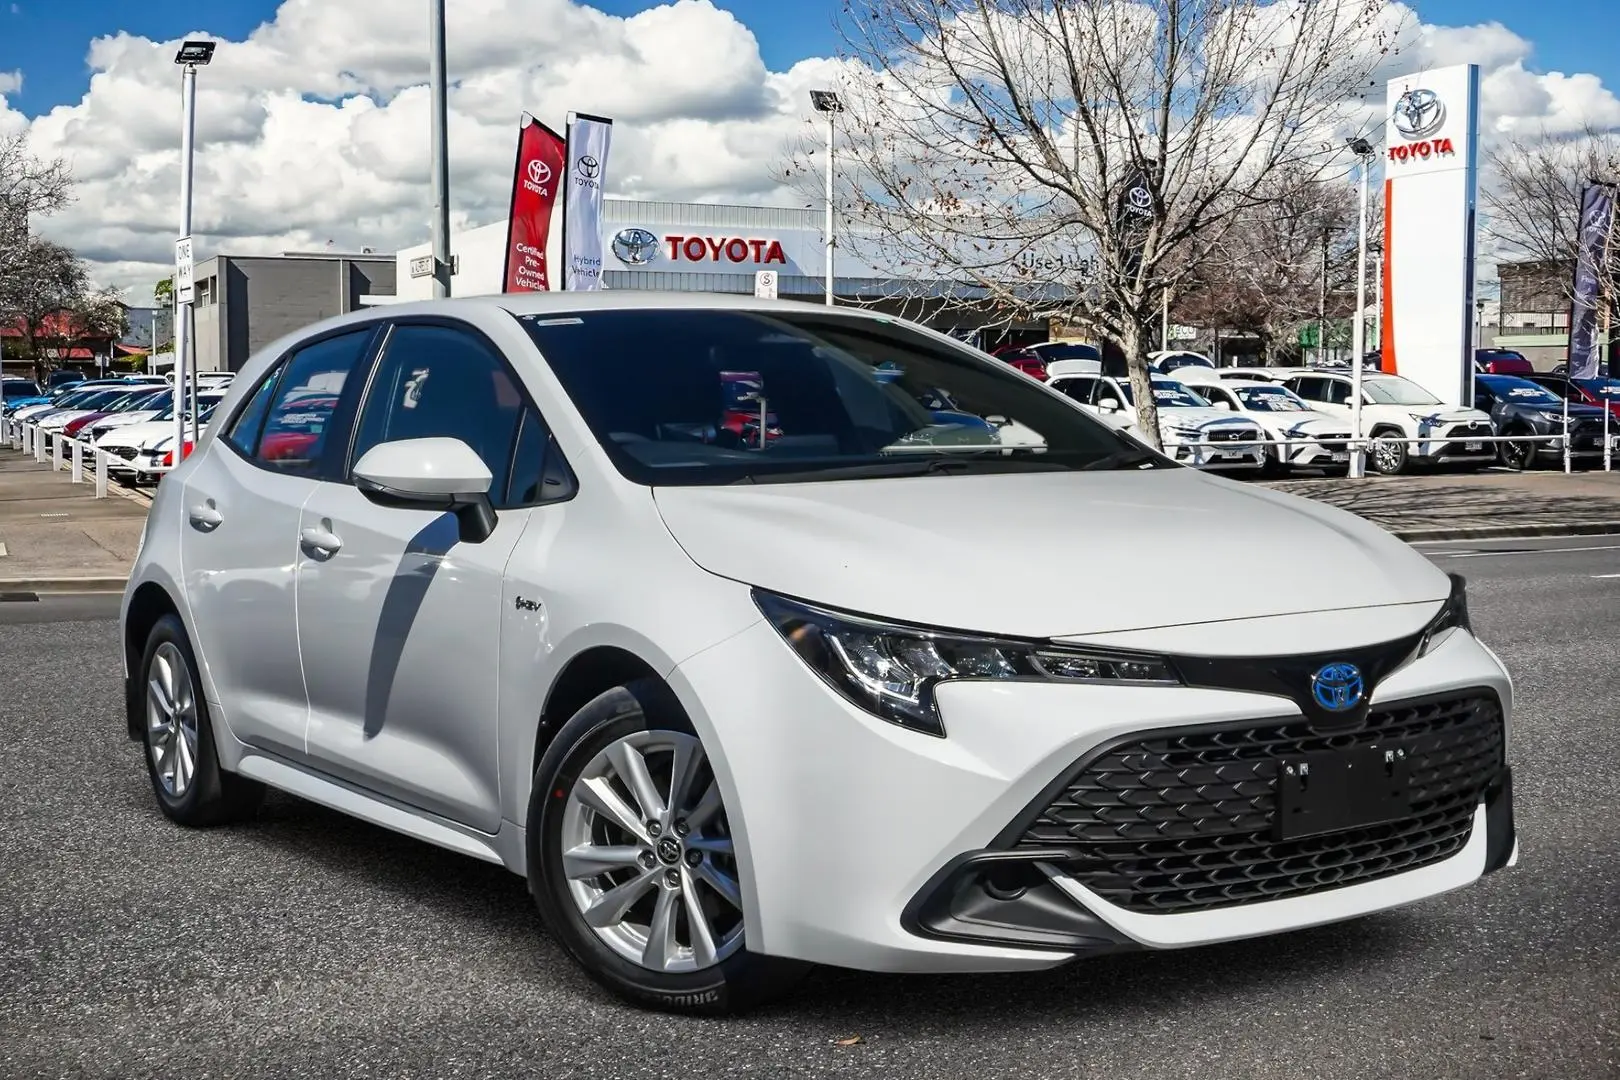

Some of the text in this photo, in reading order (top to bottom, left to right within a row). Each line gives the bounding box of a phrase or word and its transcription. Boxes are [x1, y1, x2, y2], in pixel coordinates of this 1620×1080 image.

[1388, 138, 1454, 161] TOYOTA
[523, 179, 548, 197] TOYOTA
[574, 177, 600, 190] TOYOTA
[1124, 203, 1152, 217] TOYOTA
[178, 243, 190, 260] ONE
[516, 243, 544, 259] Certified
[664, 236, 787, 264] TOYOTA
[525, 256, 540, 267] Pre-
[574, 254, 601, 266] Hybrid
[178, 264, 192, 278] WAY
[518, 266, 544, 281] Owned
